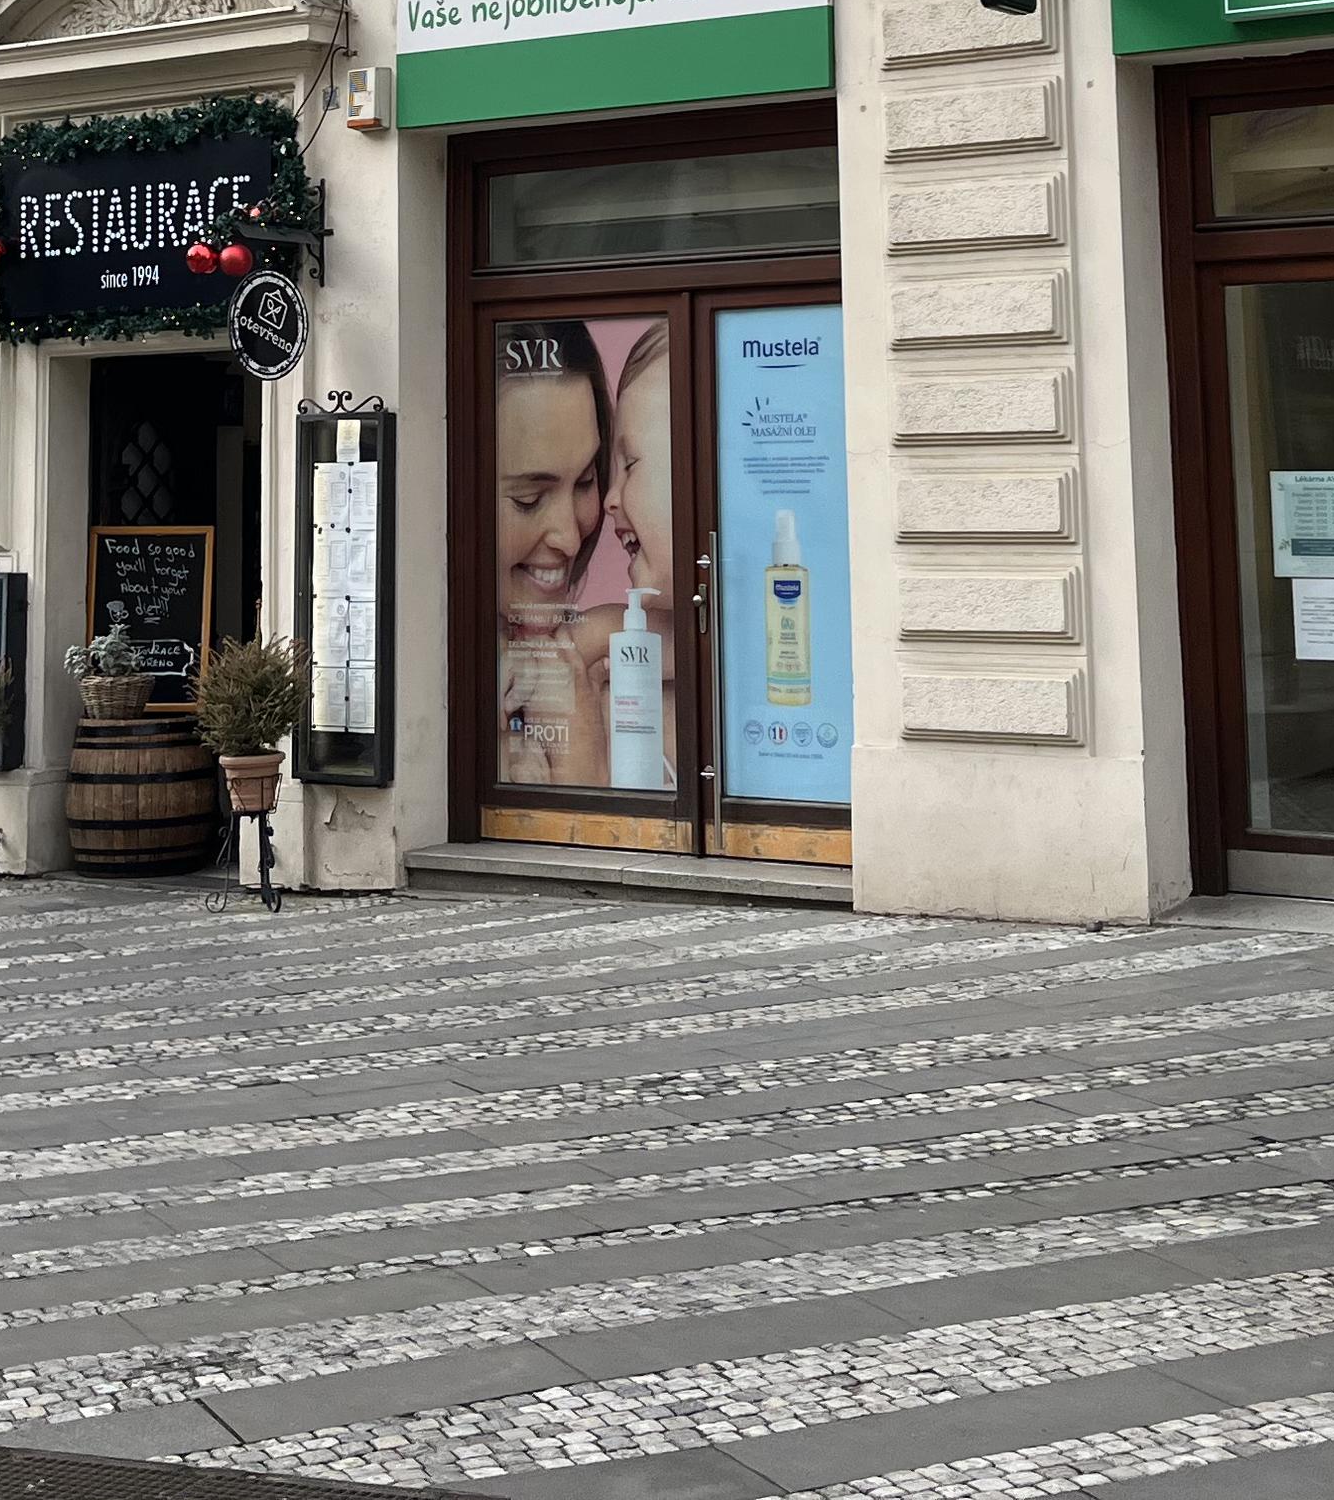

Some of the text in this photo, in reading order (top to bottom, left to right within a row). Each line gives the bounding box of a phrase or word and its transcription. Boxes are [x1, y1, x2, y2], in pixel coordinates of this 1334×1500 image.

[407, 0, 462, 32] Vaše
[100, 265, 160, 290] since 1994
[240, 316, 293, 353] otevřeno
[505, 338, 563, 370] SVR
[794, 426, 816, 437] OLEJ
[105, 538, 196, 562] Food so good
[154, 557, 190, 587] forget
[161, 587, 187, 602] your
[620, 647, 650, 664] SVR
[524, 724, 569, 742] PROTI
